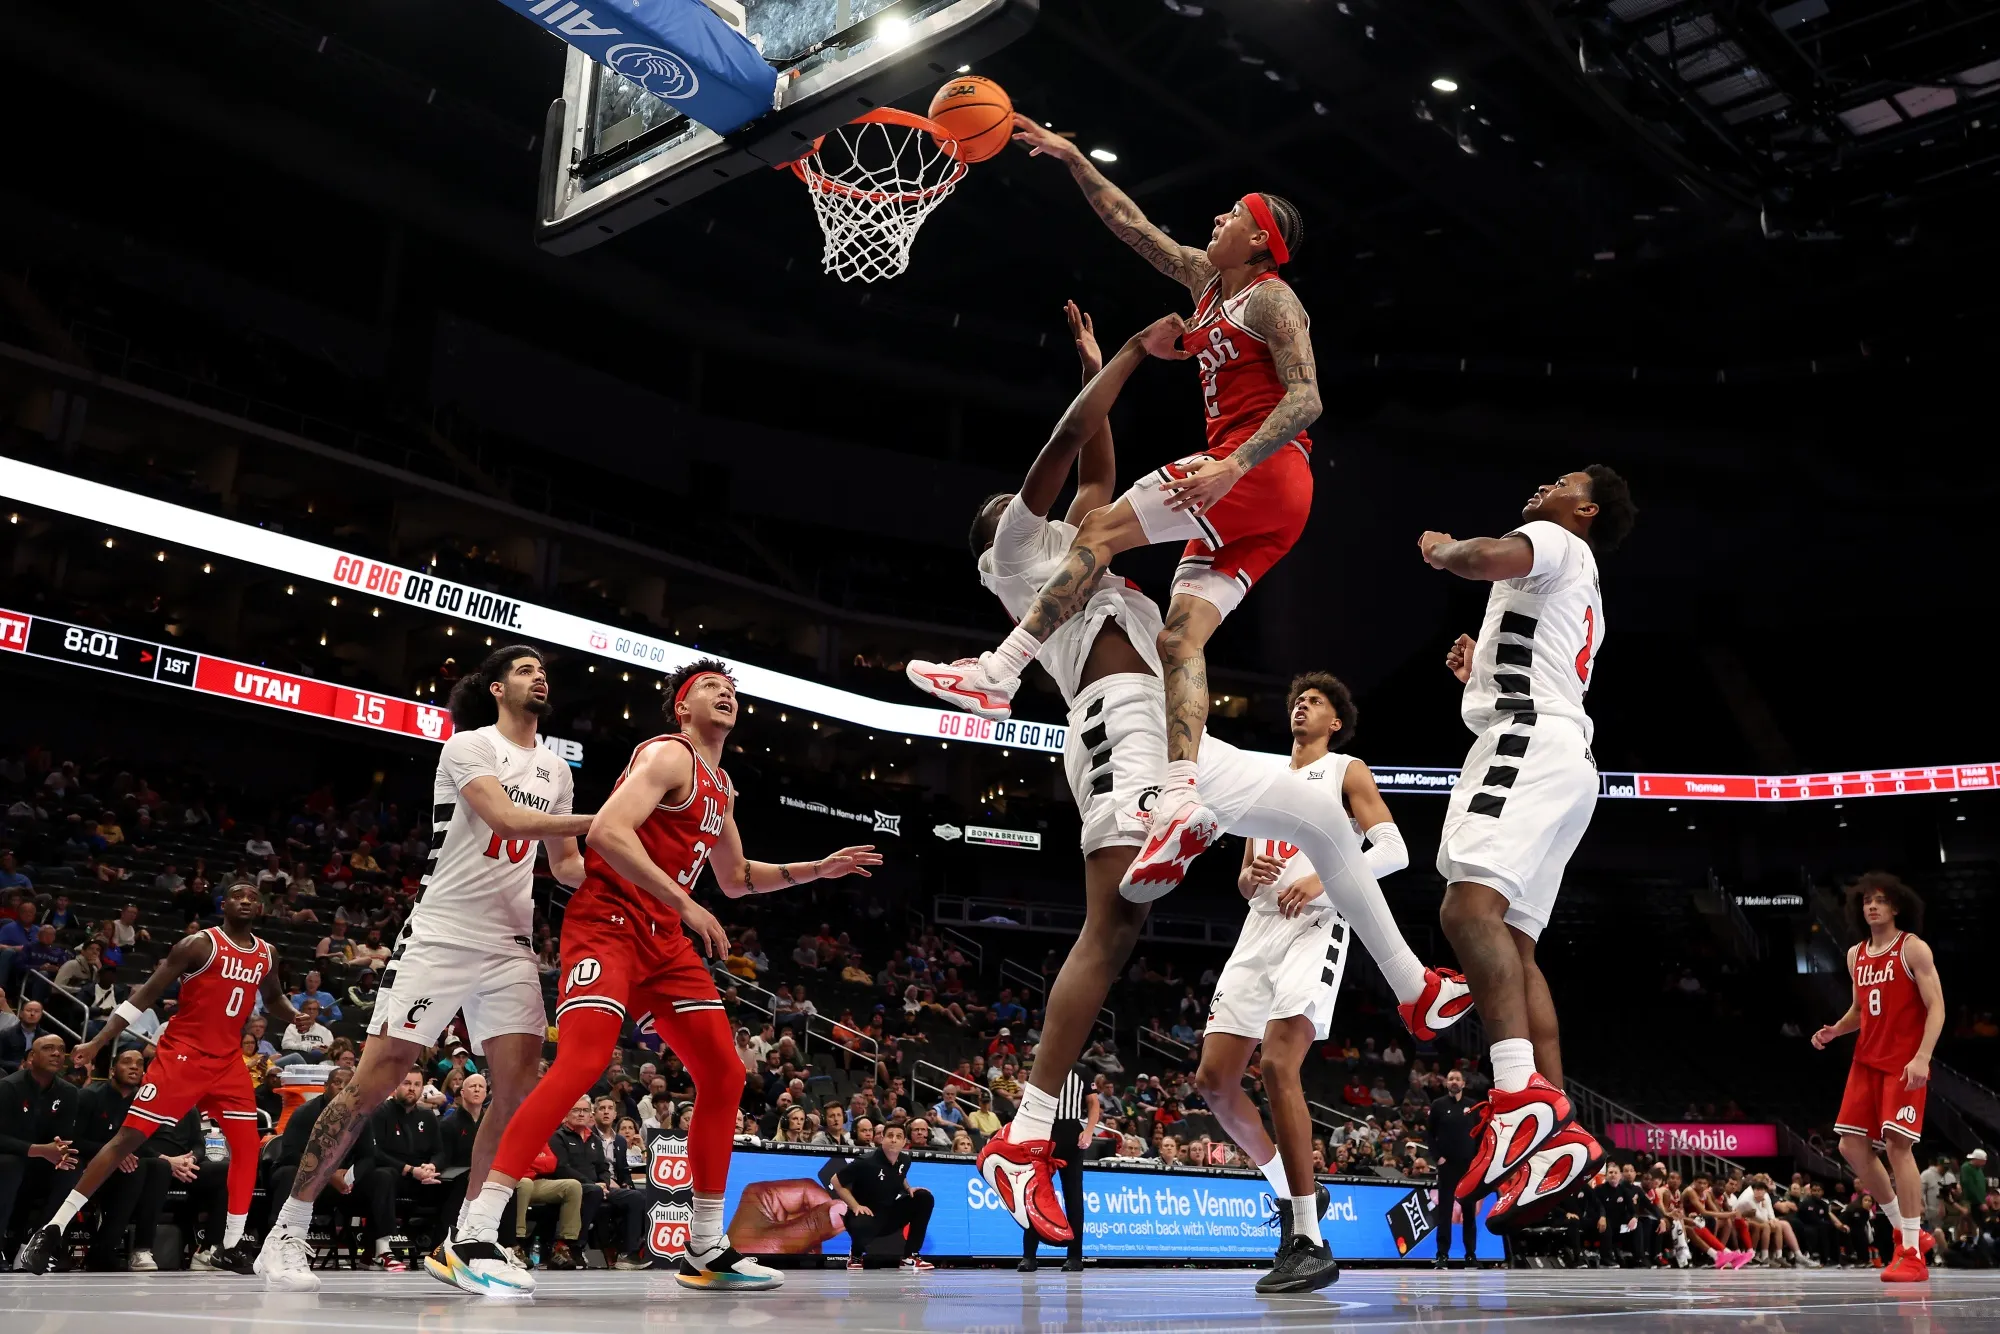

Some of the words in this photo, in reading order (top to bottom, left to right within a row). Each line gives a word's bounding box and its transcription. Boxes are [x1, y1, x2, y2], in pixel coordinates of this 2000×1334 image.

[333, 555, 364, 585] GO
[365, 564, 403, 596] BIG
[404, 575, 434, 605] OR
[435, 583, 464, 612] GO
[465, 591, 522, 629] HOME.
[63, 627, 119, 660] 8:01
[616, 637, 631, 654] GO
[632, 642, 648, 658] GO
[650, 646, 665, 663] GO
[164, 657, 191, 675] 1ST
[234, 671, 301, 705] UTAH
[352, 693, 386, 725] 15
[938, 713, 962, 735] GO
[964, 717, 992, 740] BIG
[994, 721, 1017, 743] OR
[1019, 724, 1041, 746] GO
[1685, 781, 1726, 794] Thomas
[1771, 787, 1780, 800] 0
[1801, 786, 1810, 800] 0
[1833, 784, 1843, 797] 0
[1865, 782, 1875, 796] 0
[1896, 780, 1905, 793] 0
[786, 797, 806, 810] Mobile
[836, 808, 855, 821] Home
[855, 814, 863, 822] of
[862, 814, 873, 825] the
[971, 829, 994, 839] BORN
[1001, 832, 1035, 843] BREWED
[1744, 895, 1771, 906] Mobile
[220, 955, 264, 986] Utah
[1856, 959, 1895, 987] Utah
[225, 986, 244, 1018] 0
[1868, 988, 1882, 1017] 8
[1670, 1129, 1738, 1151] Mobile
[658, 1159, 688, 1181] 66
[655, 1211, 689, 1222] PHILLIPS
[1105, 1186, 1151, 1215] with
[1155, 1188, 1191, 1217] the
[1192, 1189, 1257, 1219] Venmo
[1326, 1196, 1358, 1222] ard.
[656, 1226, 686, 1248] 66
[1082, 1222, 1127, 1239] ways-on
[1128, 1221, 1155, 1236] cash
[1156, 1219, 1180, 1236] back
[1182, 1221, 1205, 1237] with
[1205, 1221, 1240, 1237] Venmo
[1240, 1221, 1269, 1238] Stash
